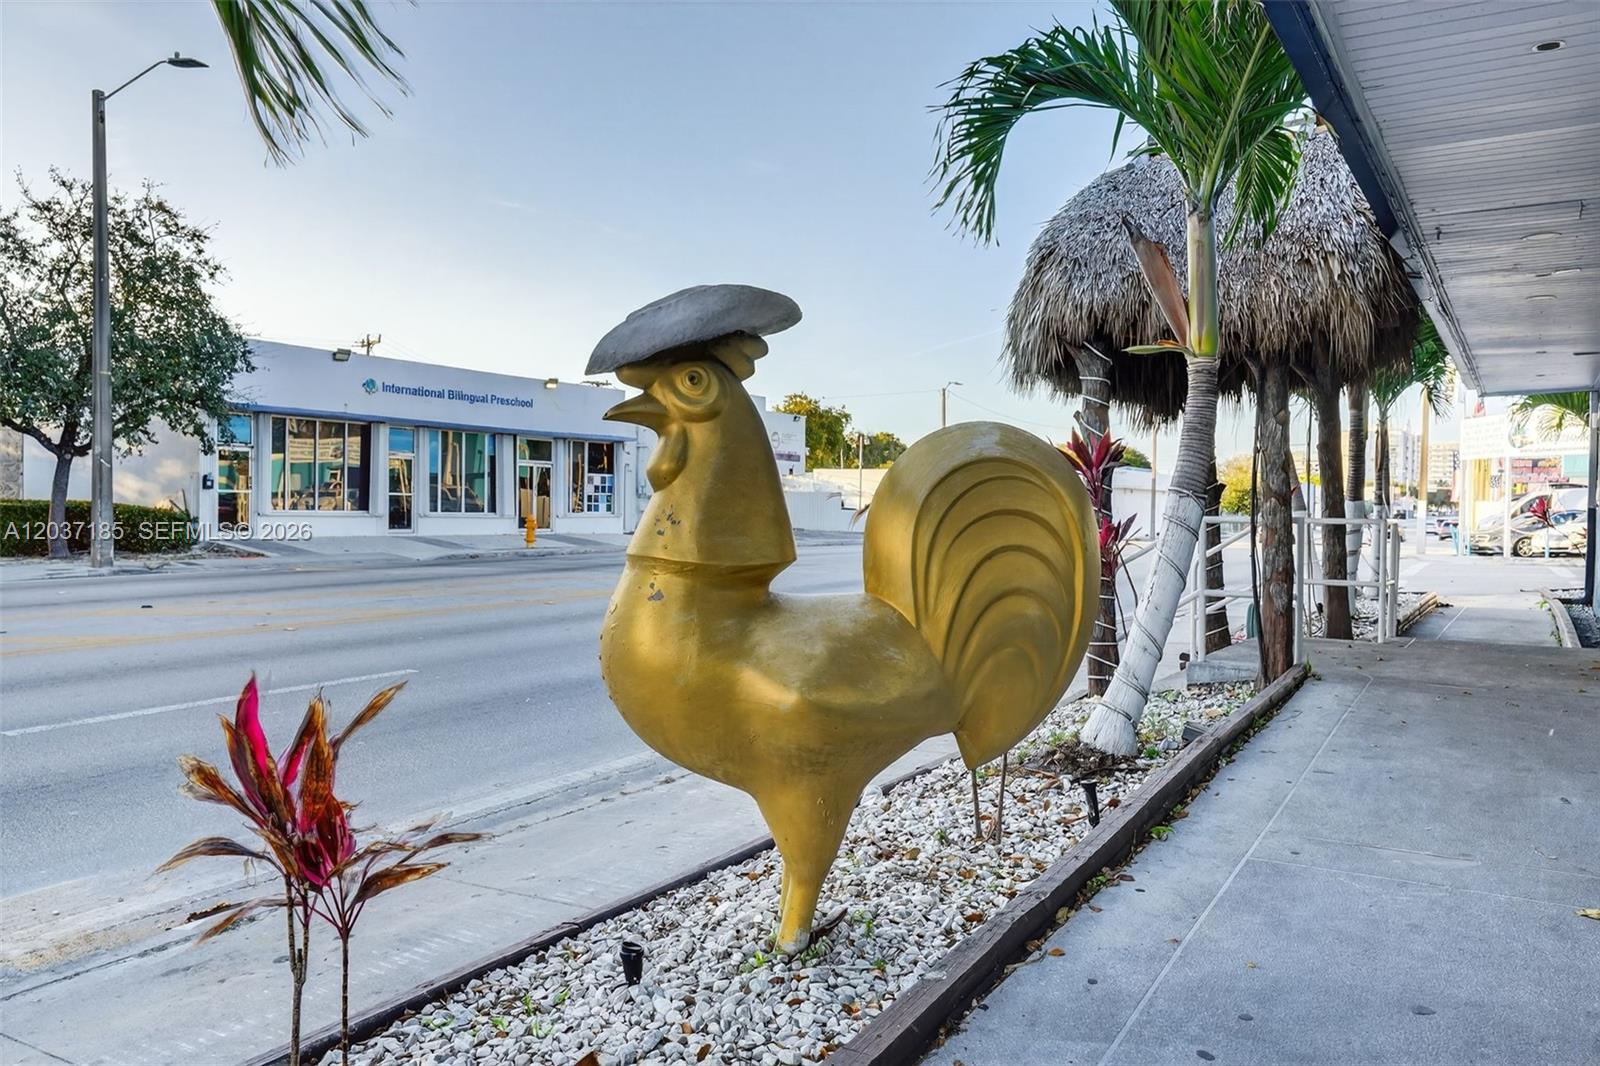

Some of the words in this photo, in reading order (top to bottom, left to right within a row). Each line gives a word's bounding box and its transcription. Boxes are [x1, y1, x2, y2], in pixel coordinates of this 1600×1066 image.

[382, 381, 445, 399] International
[447, 389, 488, 405] Bilingual
[490, 394, 534, 409] Preschool
